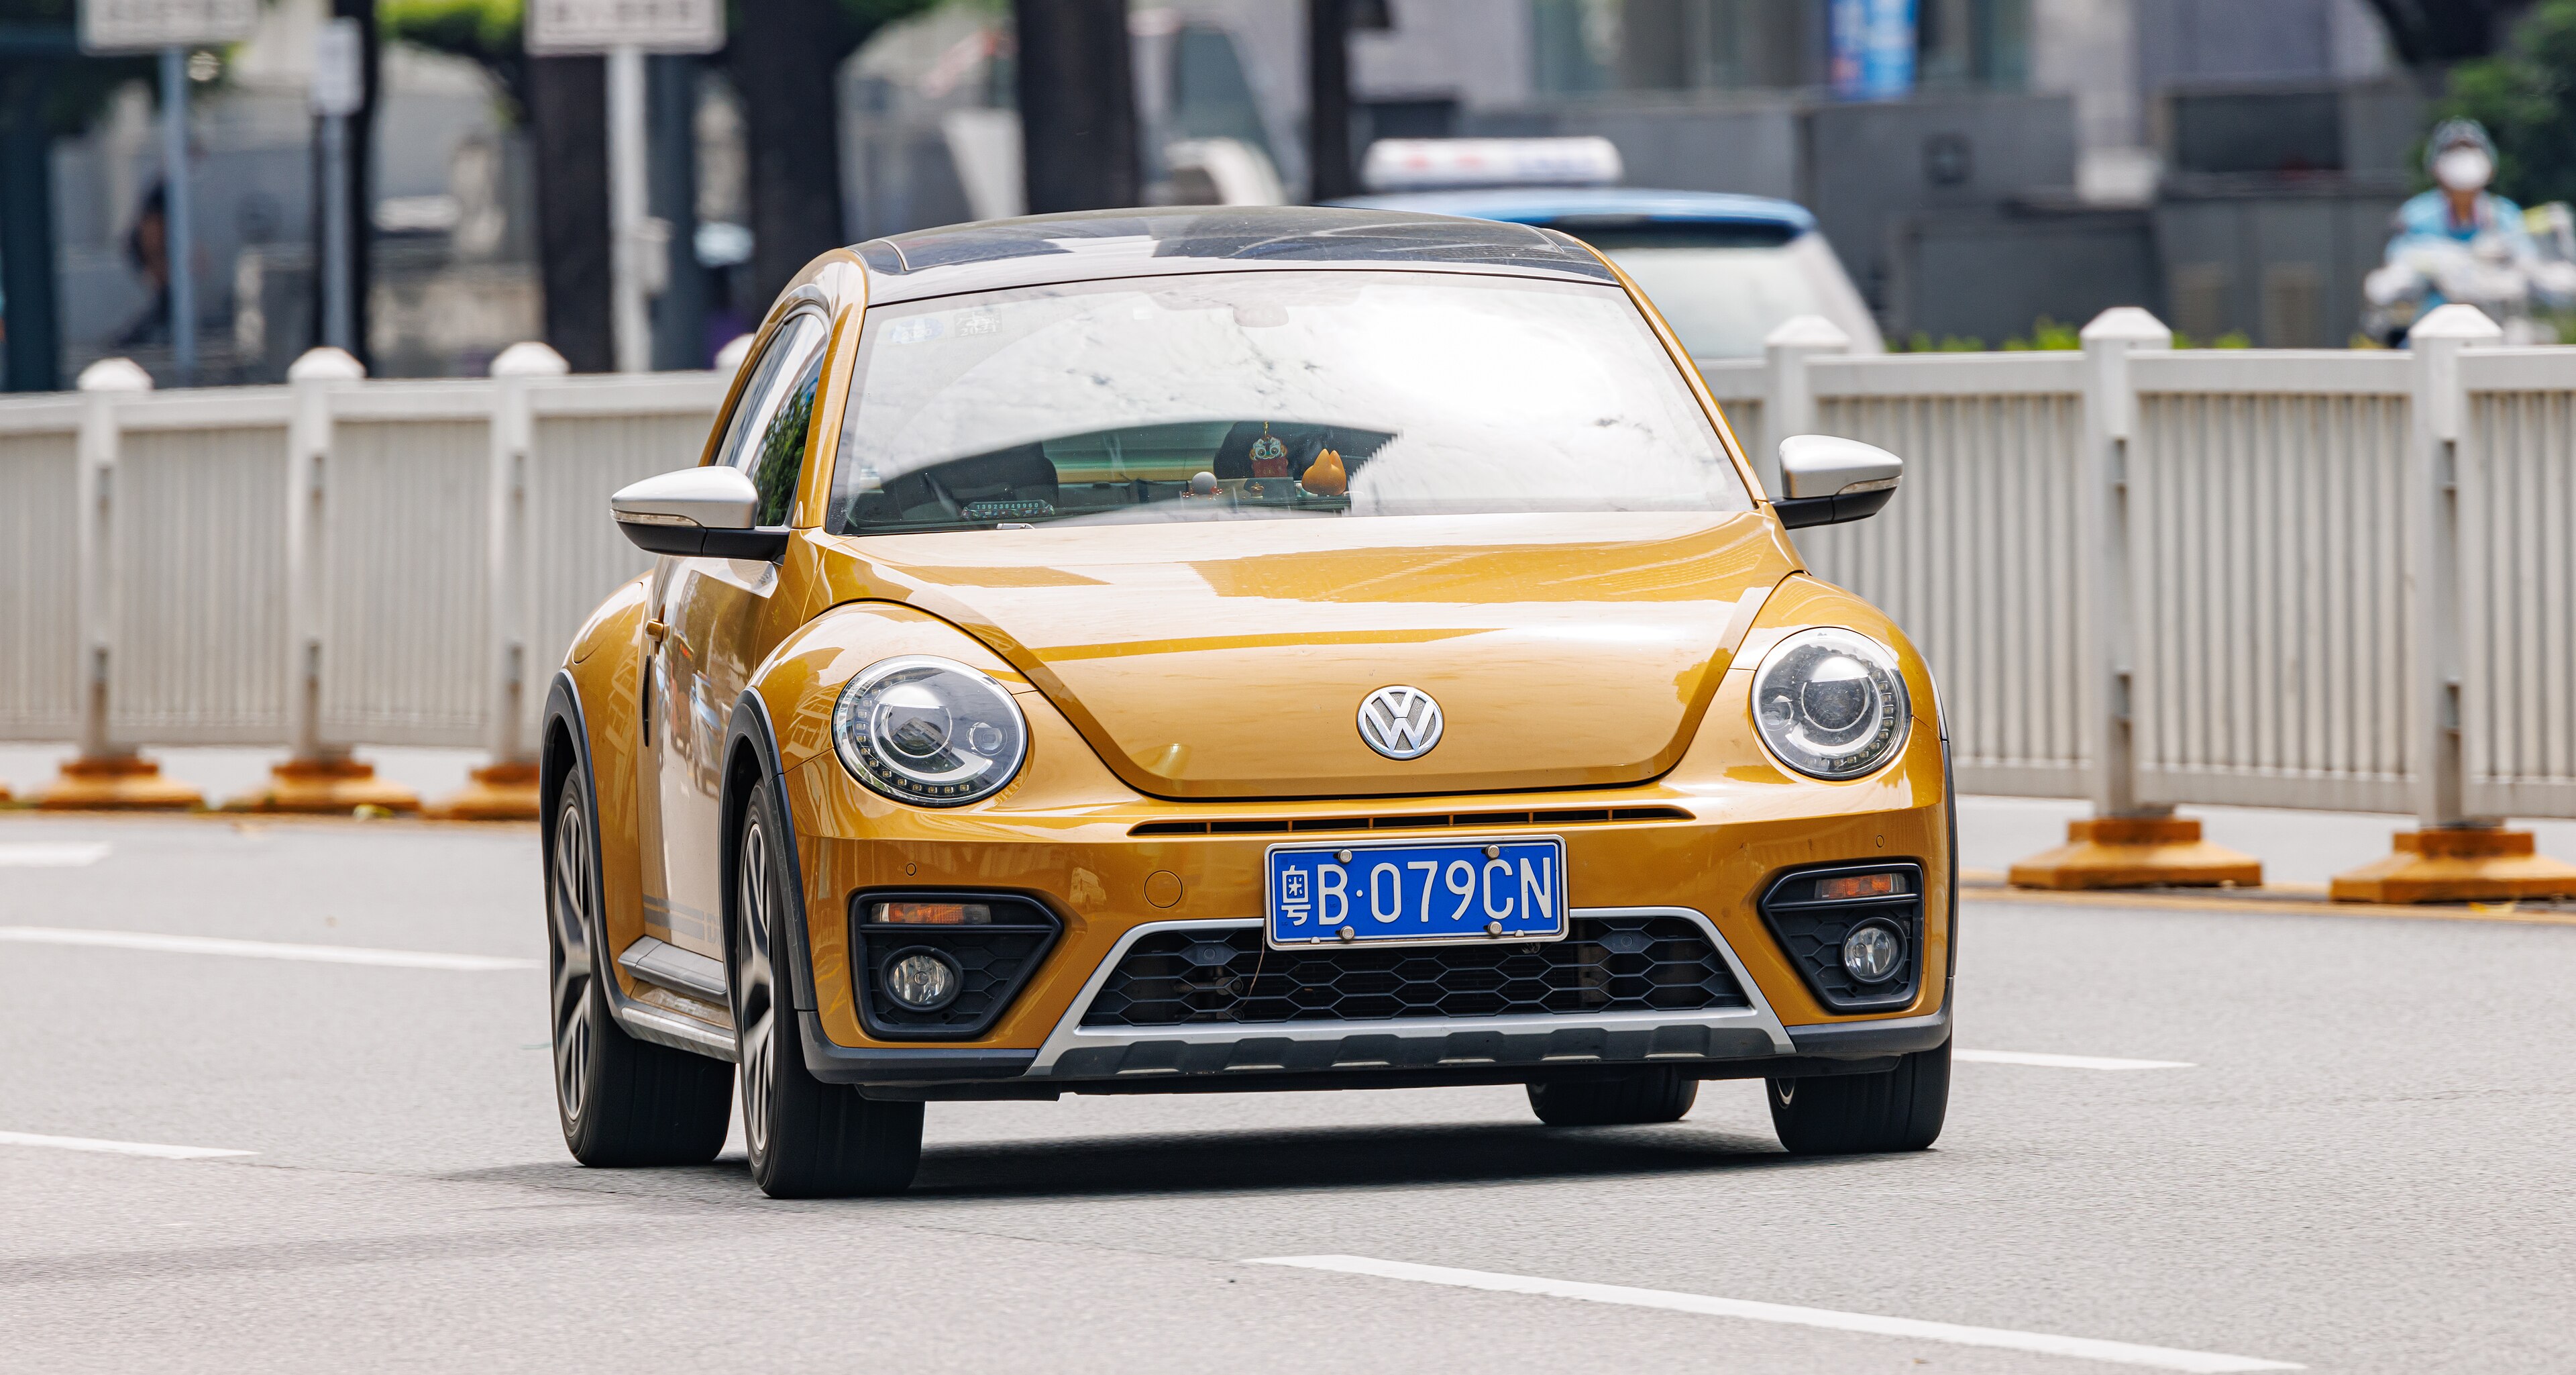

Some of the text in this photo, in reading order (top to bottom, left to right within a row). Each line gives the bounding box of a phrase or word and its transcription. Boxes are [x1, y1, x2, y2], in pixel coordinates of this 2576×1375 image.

[960, 325, 997, 336] 2021
[1358, 686, 1442, 757] VW
[1281, 857, 1552, 926] 粤B·079CN
